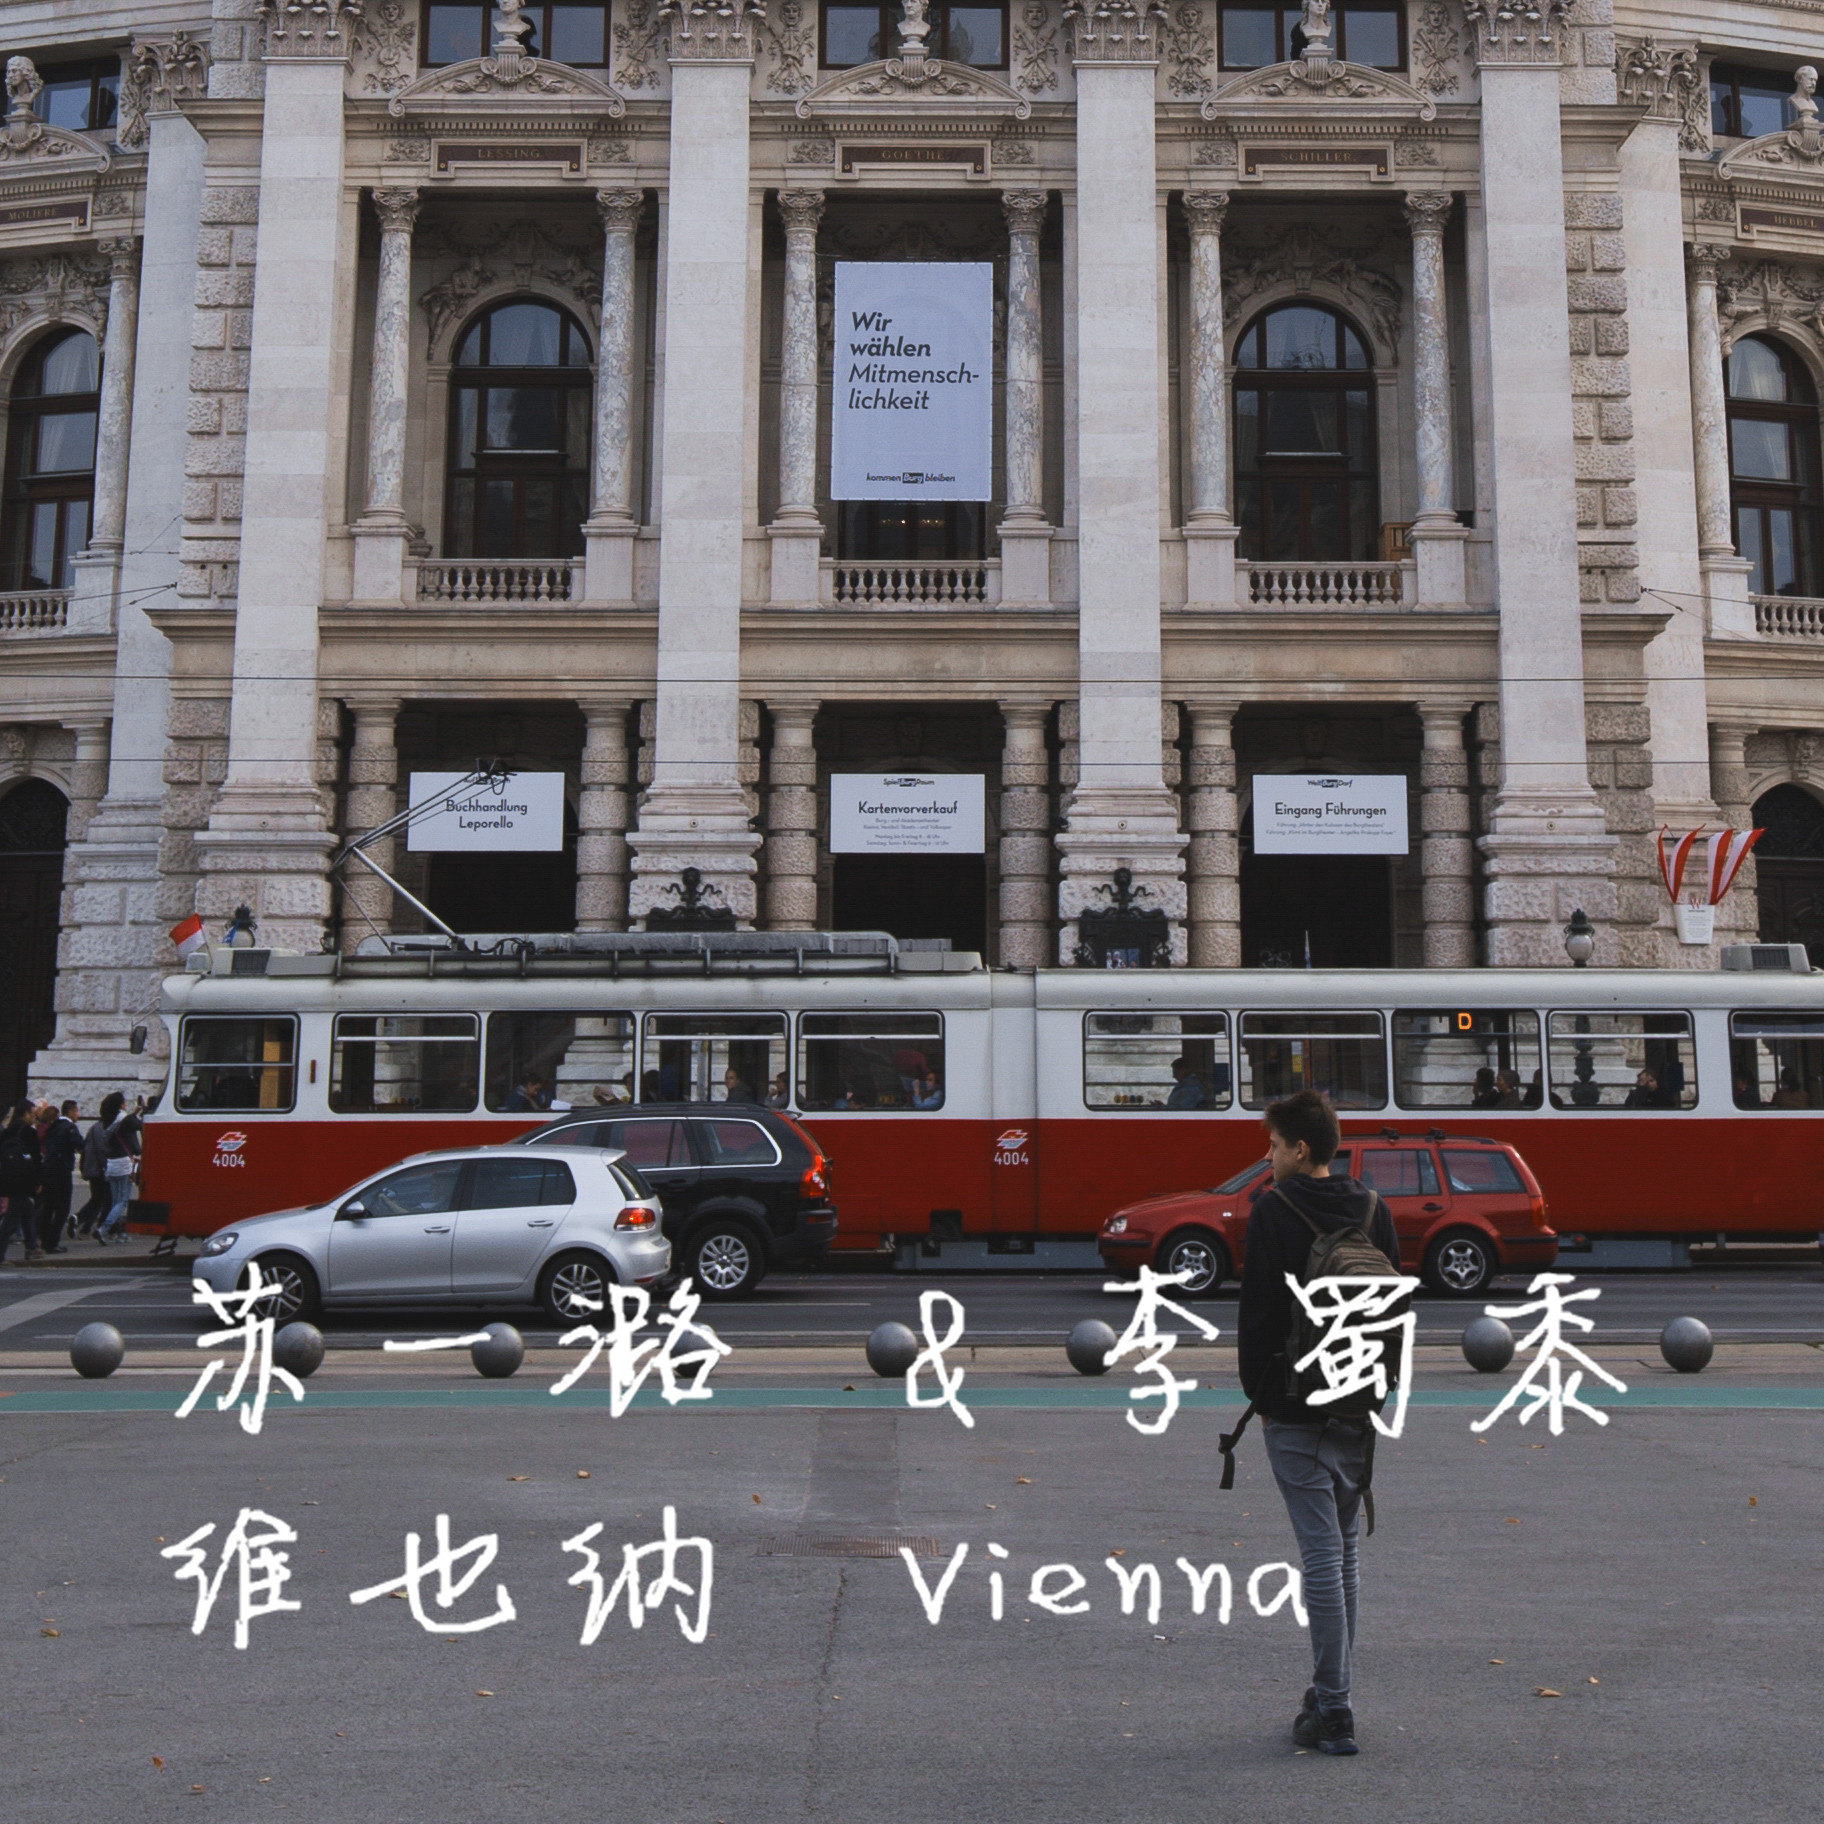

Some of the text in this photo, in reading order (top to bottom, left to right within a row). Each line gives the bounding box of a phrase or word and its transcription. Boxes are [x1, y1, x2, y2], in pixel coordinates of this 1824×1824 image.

[851, 311, 893, 331] Wir
[849, 335, 931, 357] wählen
[848, 362, 980, 384] Mitmensch-
[848, 388, 930, 410] lichkeit
[446, 799, 528, 815] Buchhandlung
[858, 801, 958, 815] Kartenvorverkauf
[1274, 802, 1387, 819] Eingang Führungen
[459, 815, 514, 831] Leporello
[1458, 1012, 1472, 1030] D
[212, 1153, 246, 1168] 4004
[994, 1152, 1029, 1165] 4004
